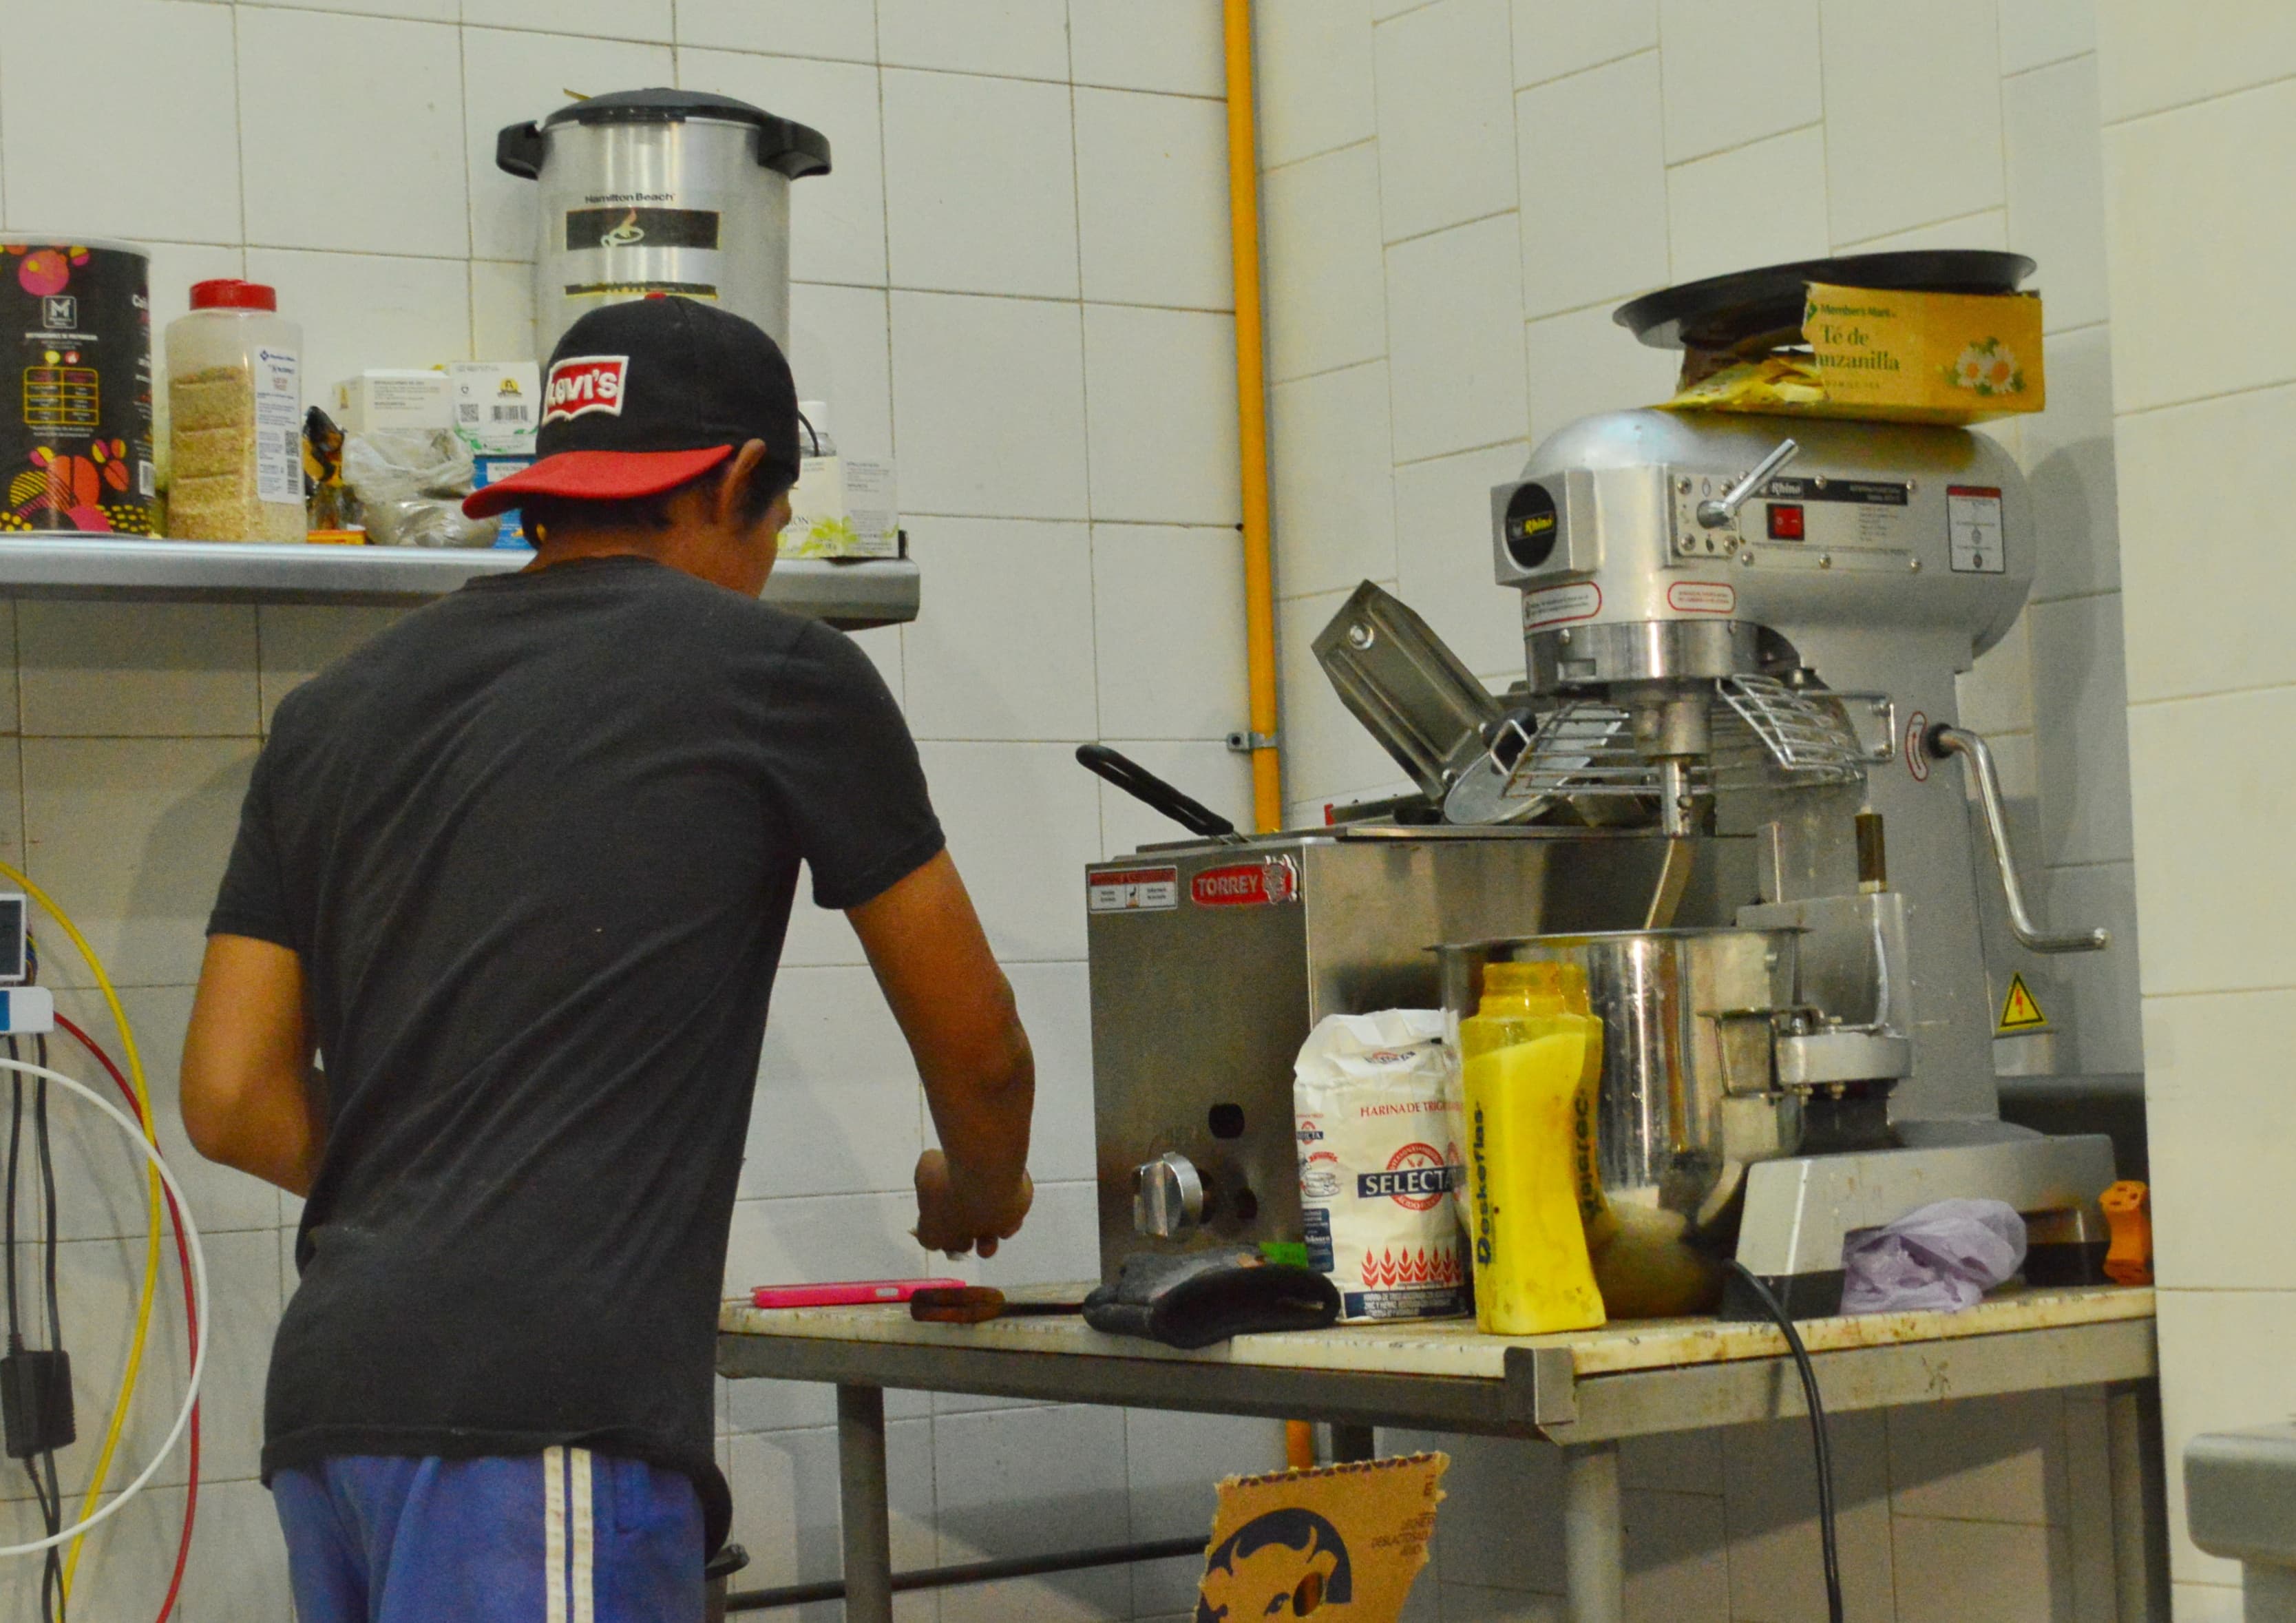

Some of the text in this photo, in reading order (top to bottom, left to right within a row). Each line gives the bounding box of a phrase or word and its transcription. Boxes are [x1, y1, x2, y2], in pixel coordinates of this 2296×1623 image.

[584, 192, 674, 204] Hamilton Beach
[1847, 326, 1869, 345] de
[1197, 874, 1258, 897] TORREY
[1360, 1103, 1406, 1118] HARINA
[1407, 1102, 1420, 1113] DE
